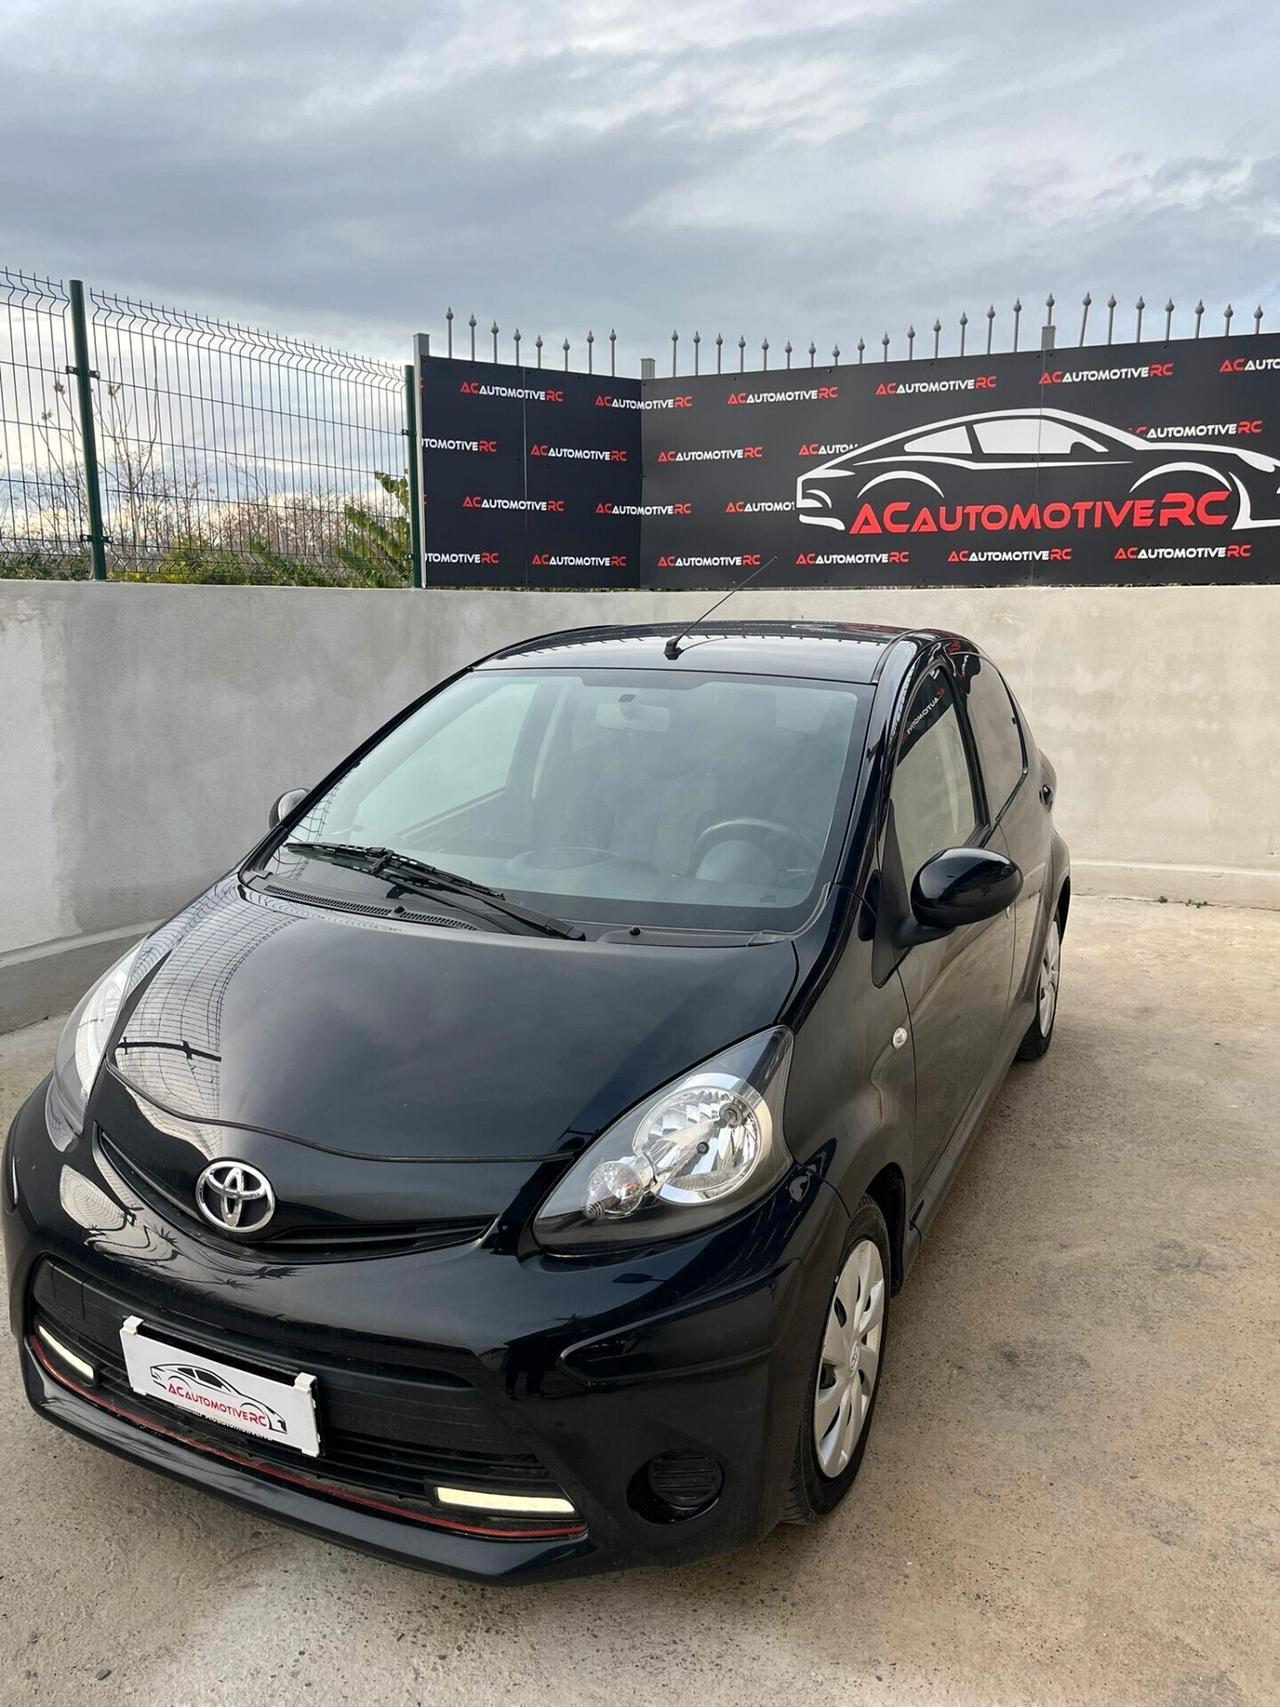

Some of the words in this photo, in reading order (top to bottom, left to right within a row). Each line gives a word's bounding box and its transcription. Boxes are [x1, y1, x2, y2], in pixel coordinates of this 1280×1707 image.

[1038, 362, 1174, 385] ACAUTOMOTIVERC
[460, 381, 564, 402] ACAUTOMOTIVERC
[875, 375, 997, 395] ACAUTOMOTIVERC
[595, 395, 693, 410] ACAUTOMOTIVERC
[727, 386, 839, 405] ACAUTOMOTIVERC
[531, 444, 627, 462] ACAUTOMOTIVERC
[657, 447, 763, 462] ACAUTOMOTIVERC
[463, 496, 565, 512] ACAUTOMOTIVERC
[595, 503, 692, 516] ACAUTOMOTIVERC
[849, 490, 1230, 535] ACAUTOMOTIVERC
[532, 554, 627, 567] ACAUTOMOTIVERC
[795, 551, 909, 565] ACAUTOMOTIVERC
[947, 548, 1072, 563] ACAUTOMOTIVERC
[1114, 543, 1252, 561] ACAUTOMOTIVERC
[658, 554, 761, 568] ACAUTOMOTIVERC
[168, 1382, 268, 1428] ACAUTOMOTIVERC
